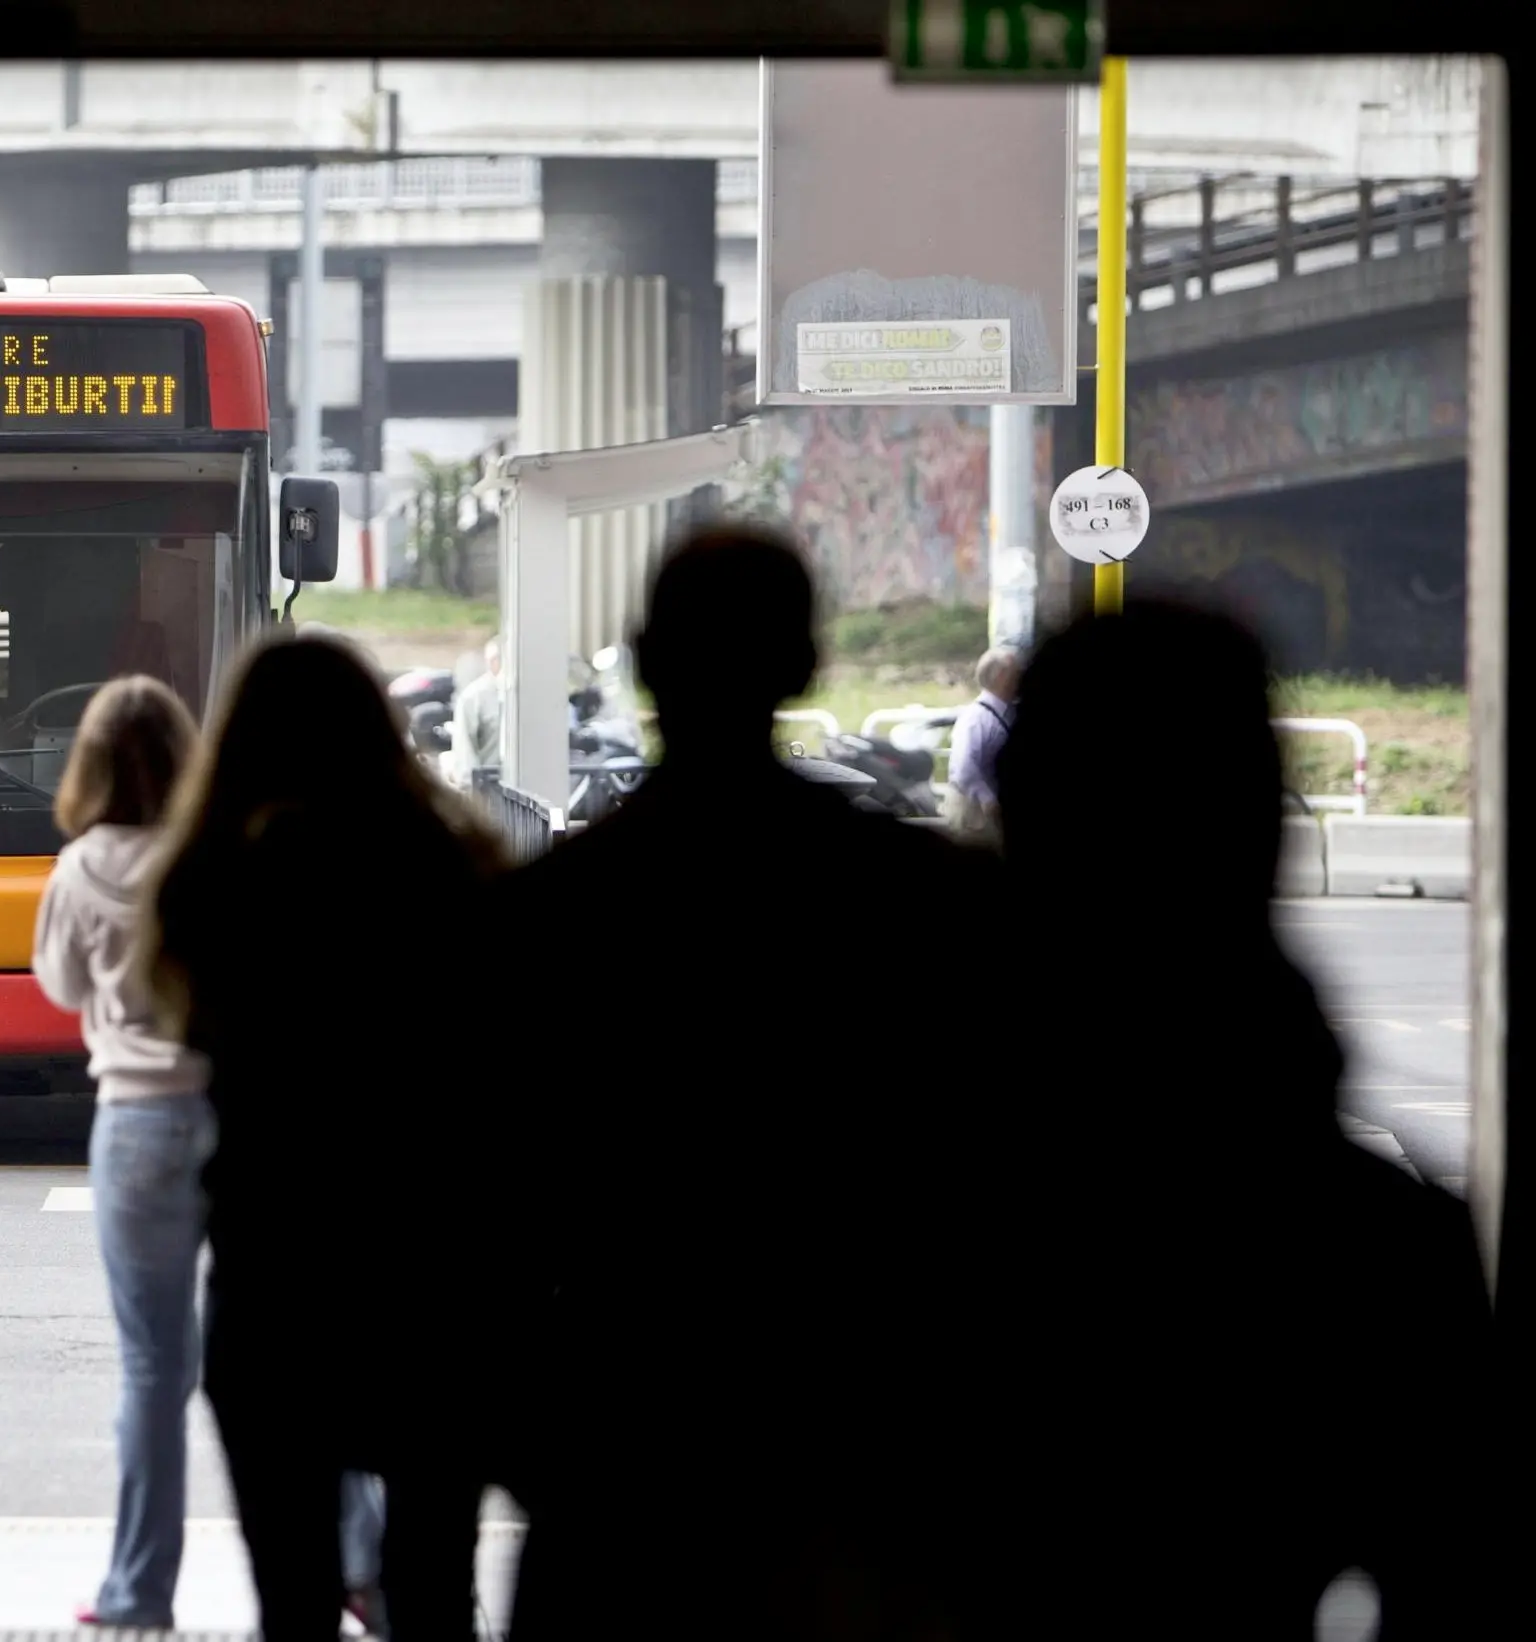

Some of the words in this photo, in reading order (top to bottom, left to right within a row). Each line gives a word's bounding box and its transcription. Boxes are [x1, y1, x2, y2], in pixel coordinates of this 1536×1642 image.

[912, 358, 1002, 378] SANDRO!
[1066, 500, 1089, 512] 491
[1108, 499, 1131, 511] 168
[1089, 518, 1108, 530] C3
